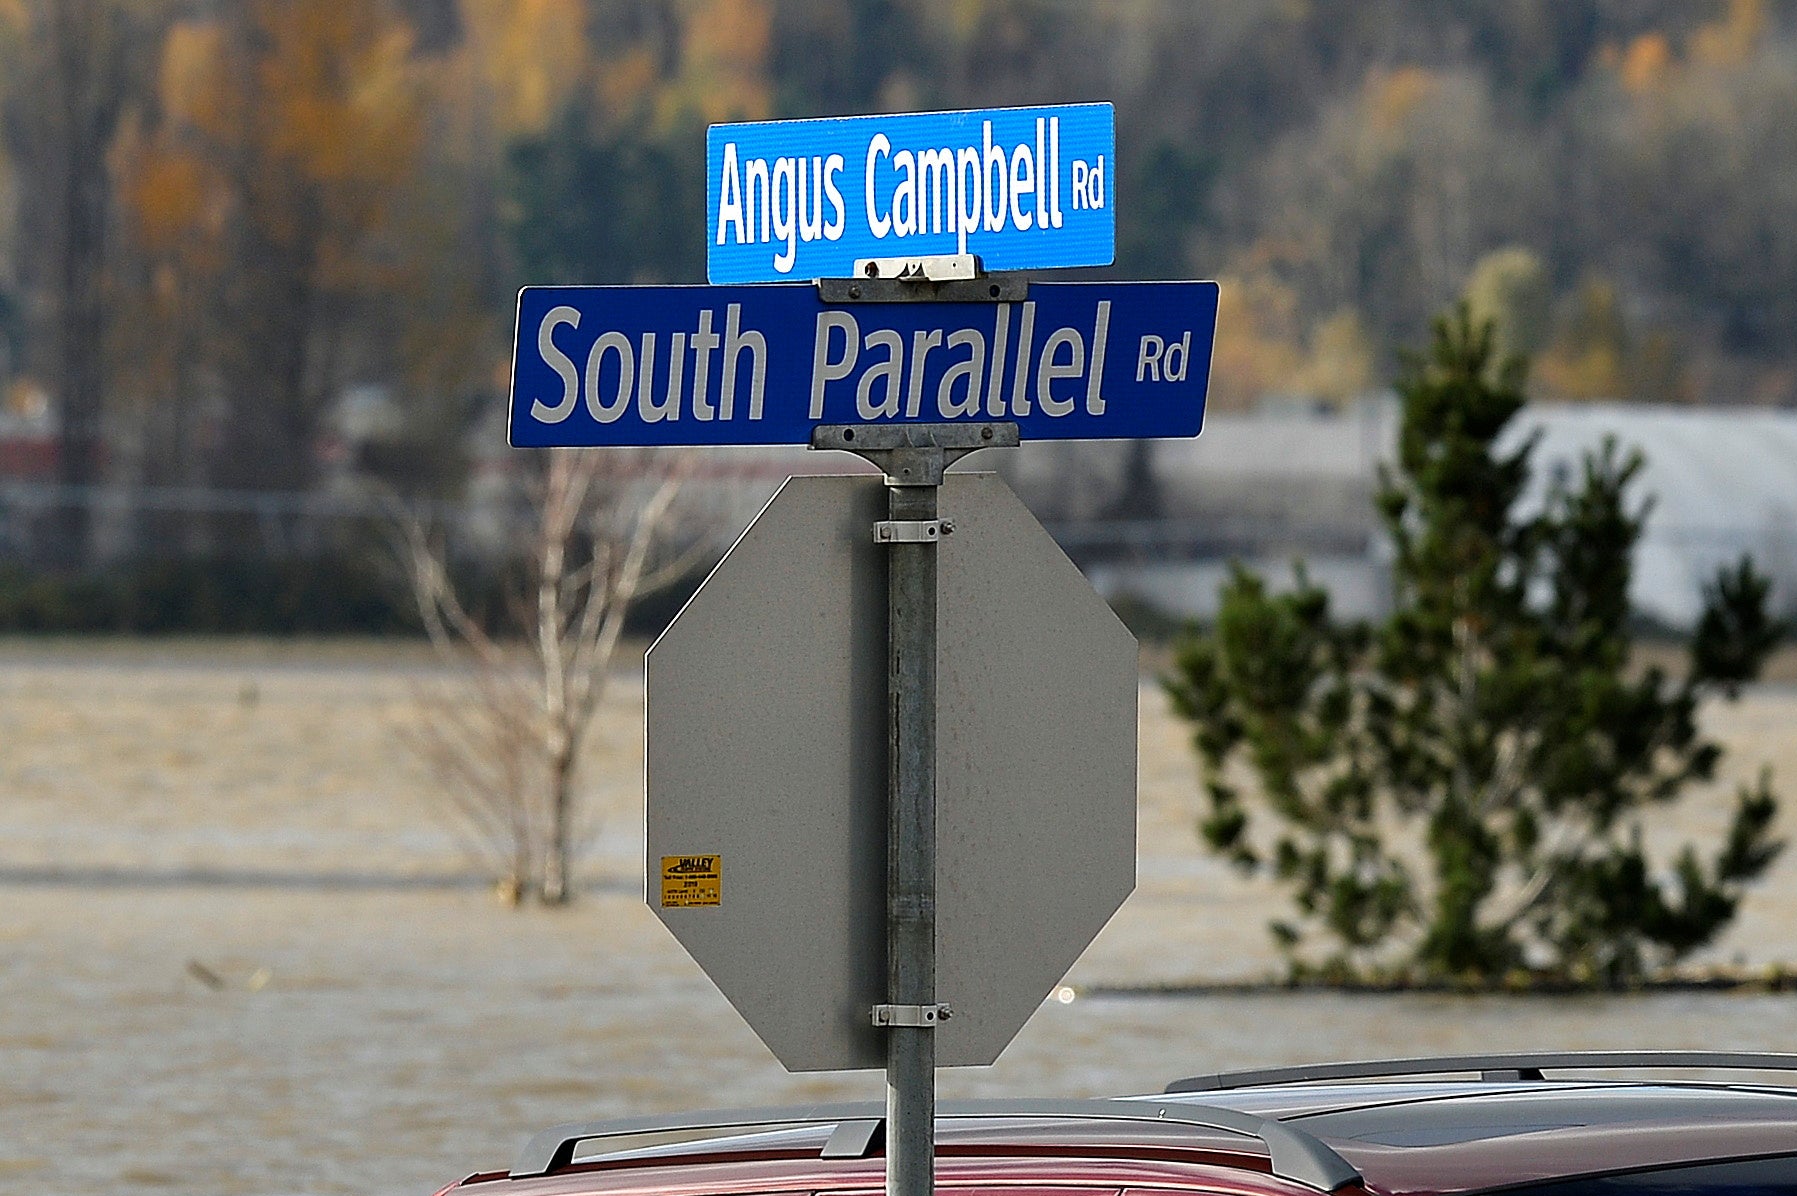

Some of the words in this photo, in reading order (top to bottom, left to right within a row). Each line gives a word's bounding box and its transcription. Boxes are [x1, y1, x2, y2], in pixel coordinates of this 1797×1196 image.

[716, 142, 845, 273] Angus
[865, 117, 1063, 256] Campbell
[1072, 155, 1105, 210] Rd
[530, 303, 767, 424] South
[808, 301, 1111, 421] Parallel
[1136, 331, 1191, 382] Rd
[679, 858, 714, 869] VALLEY
